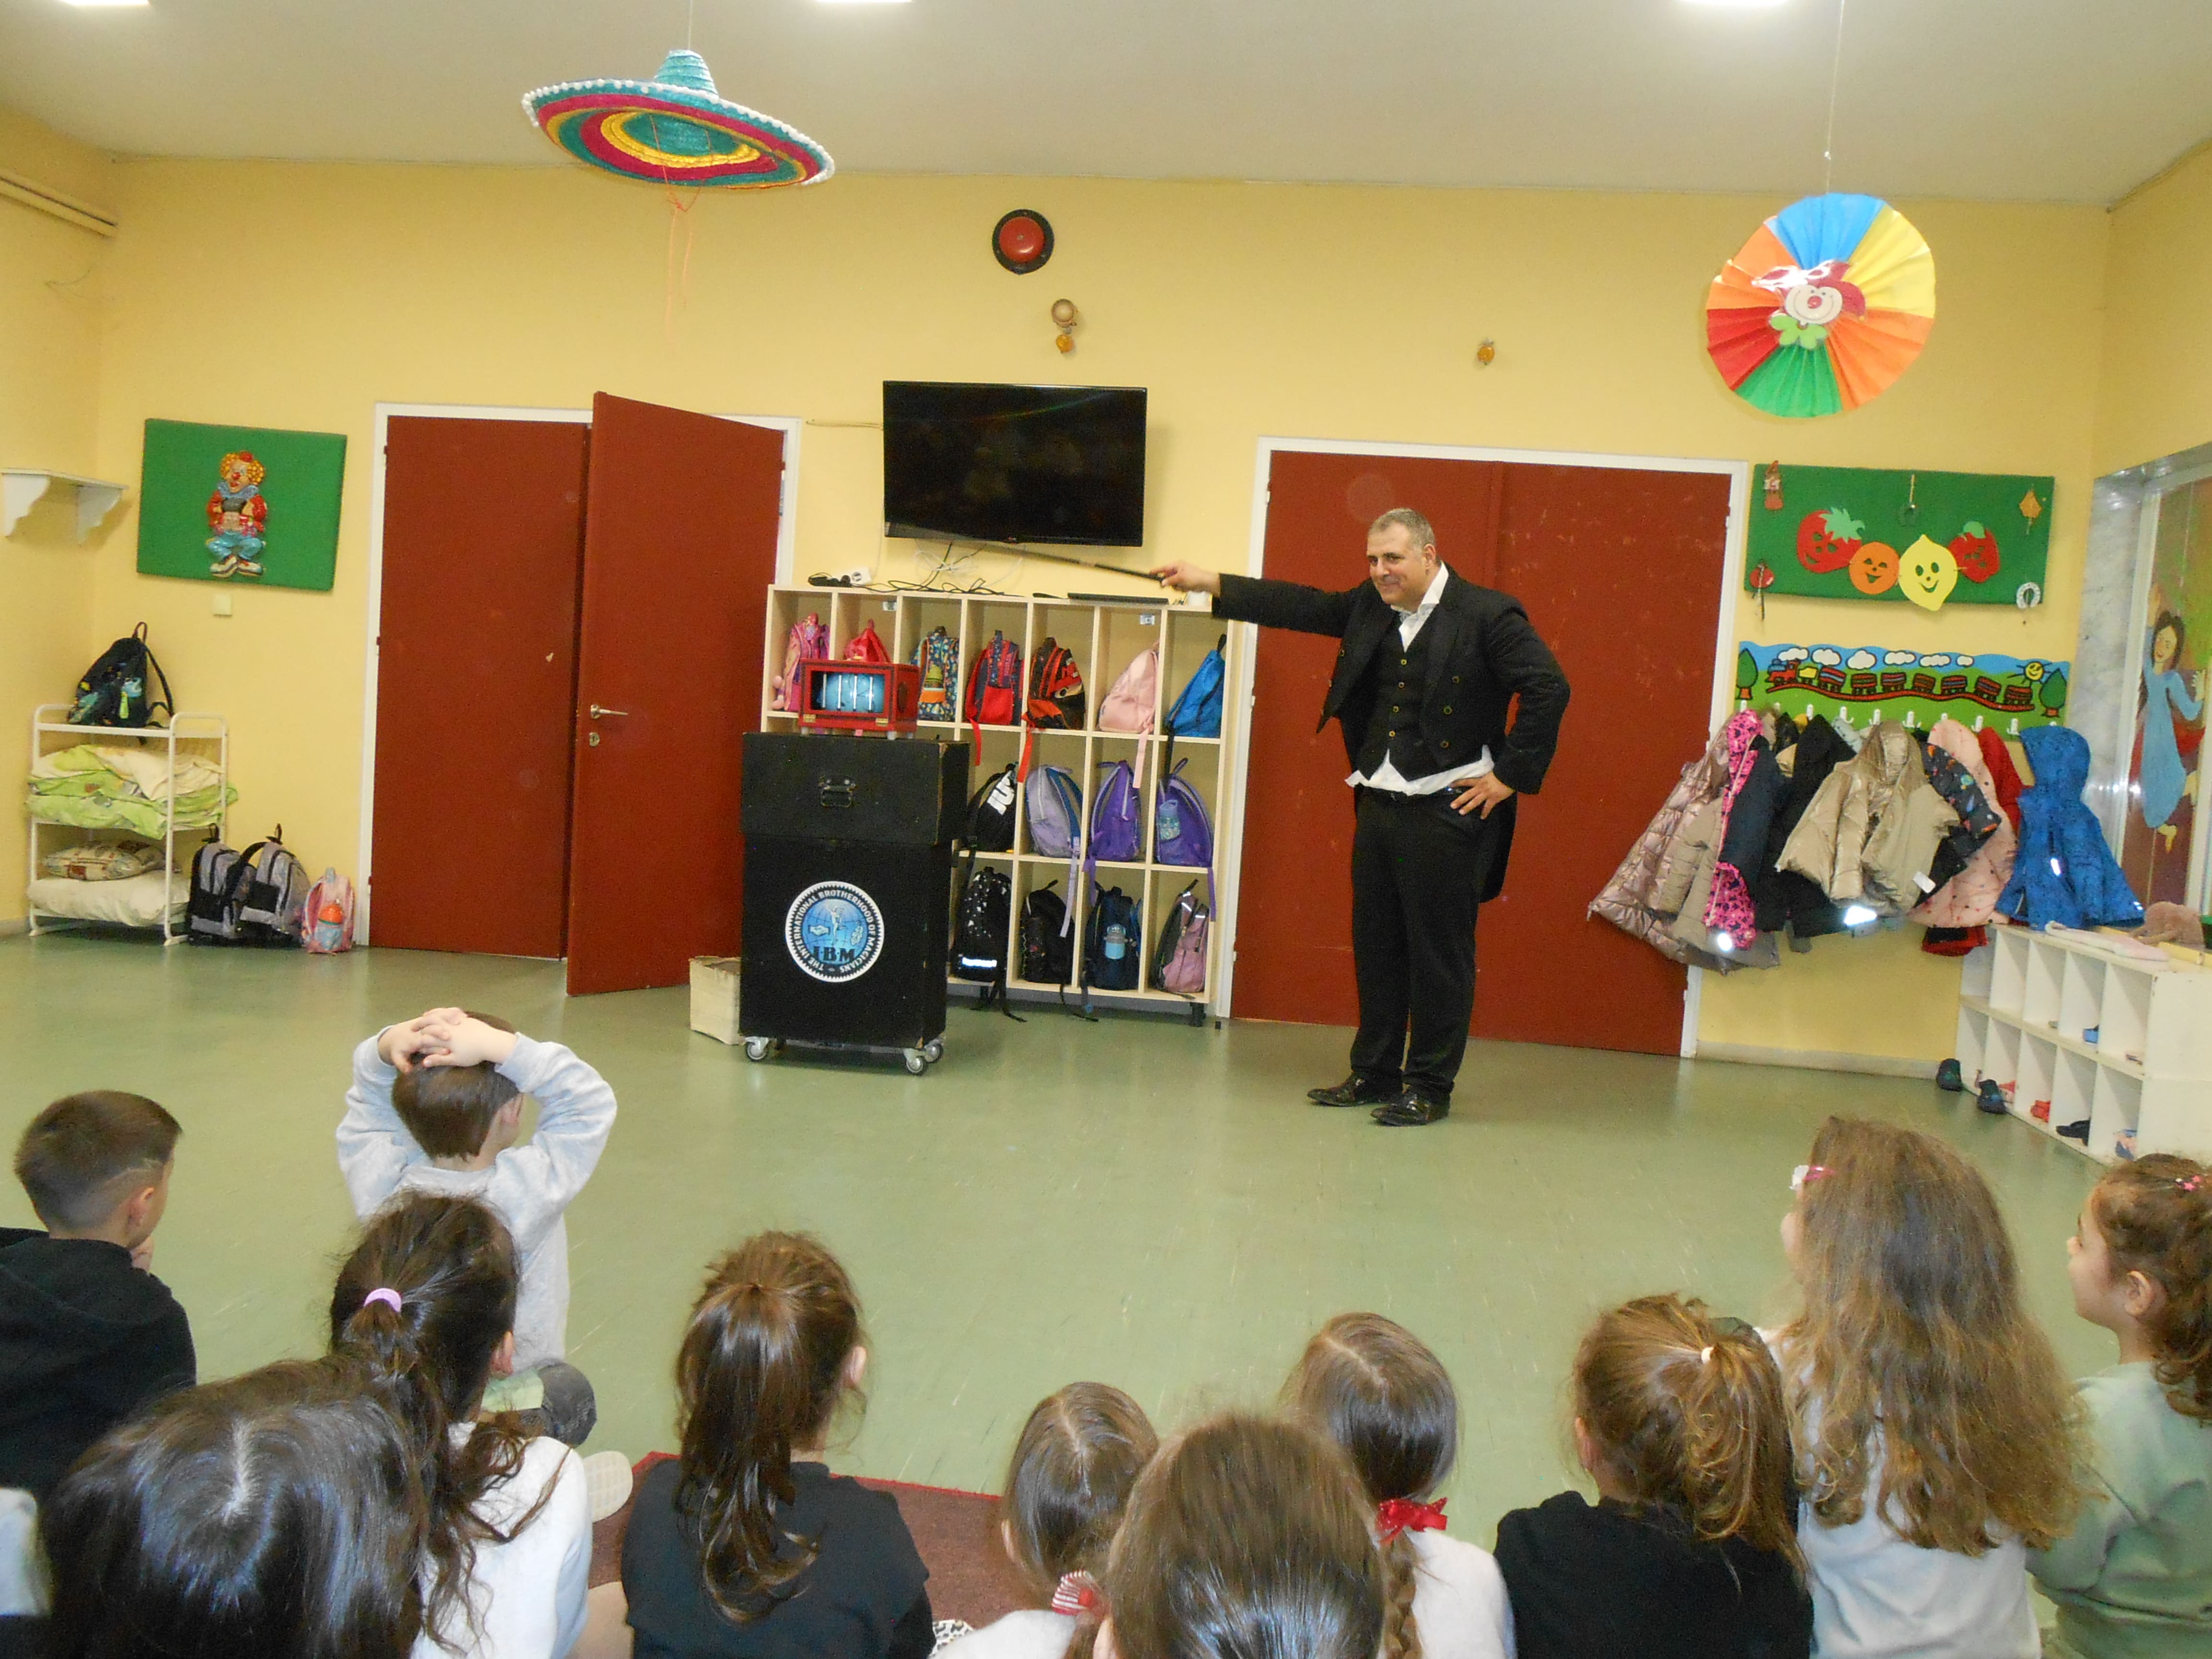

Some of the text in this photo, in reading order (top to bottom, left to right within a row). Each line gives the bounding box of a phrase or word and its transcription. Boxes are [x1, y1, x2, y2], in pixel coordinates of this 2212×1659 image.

[794, 890, 876, 973] THE INTERNATIONAL BROTHERHOOD OF MAGICIANS
